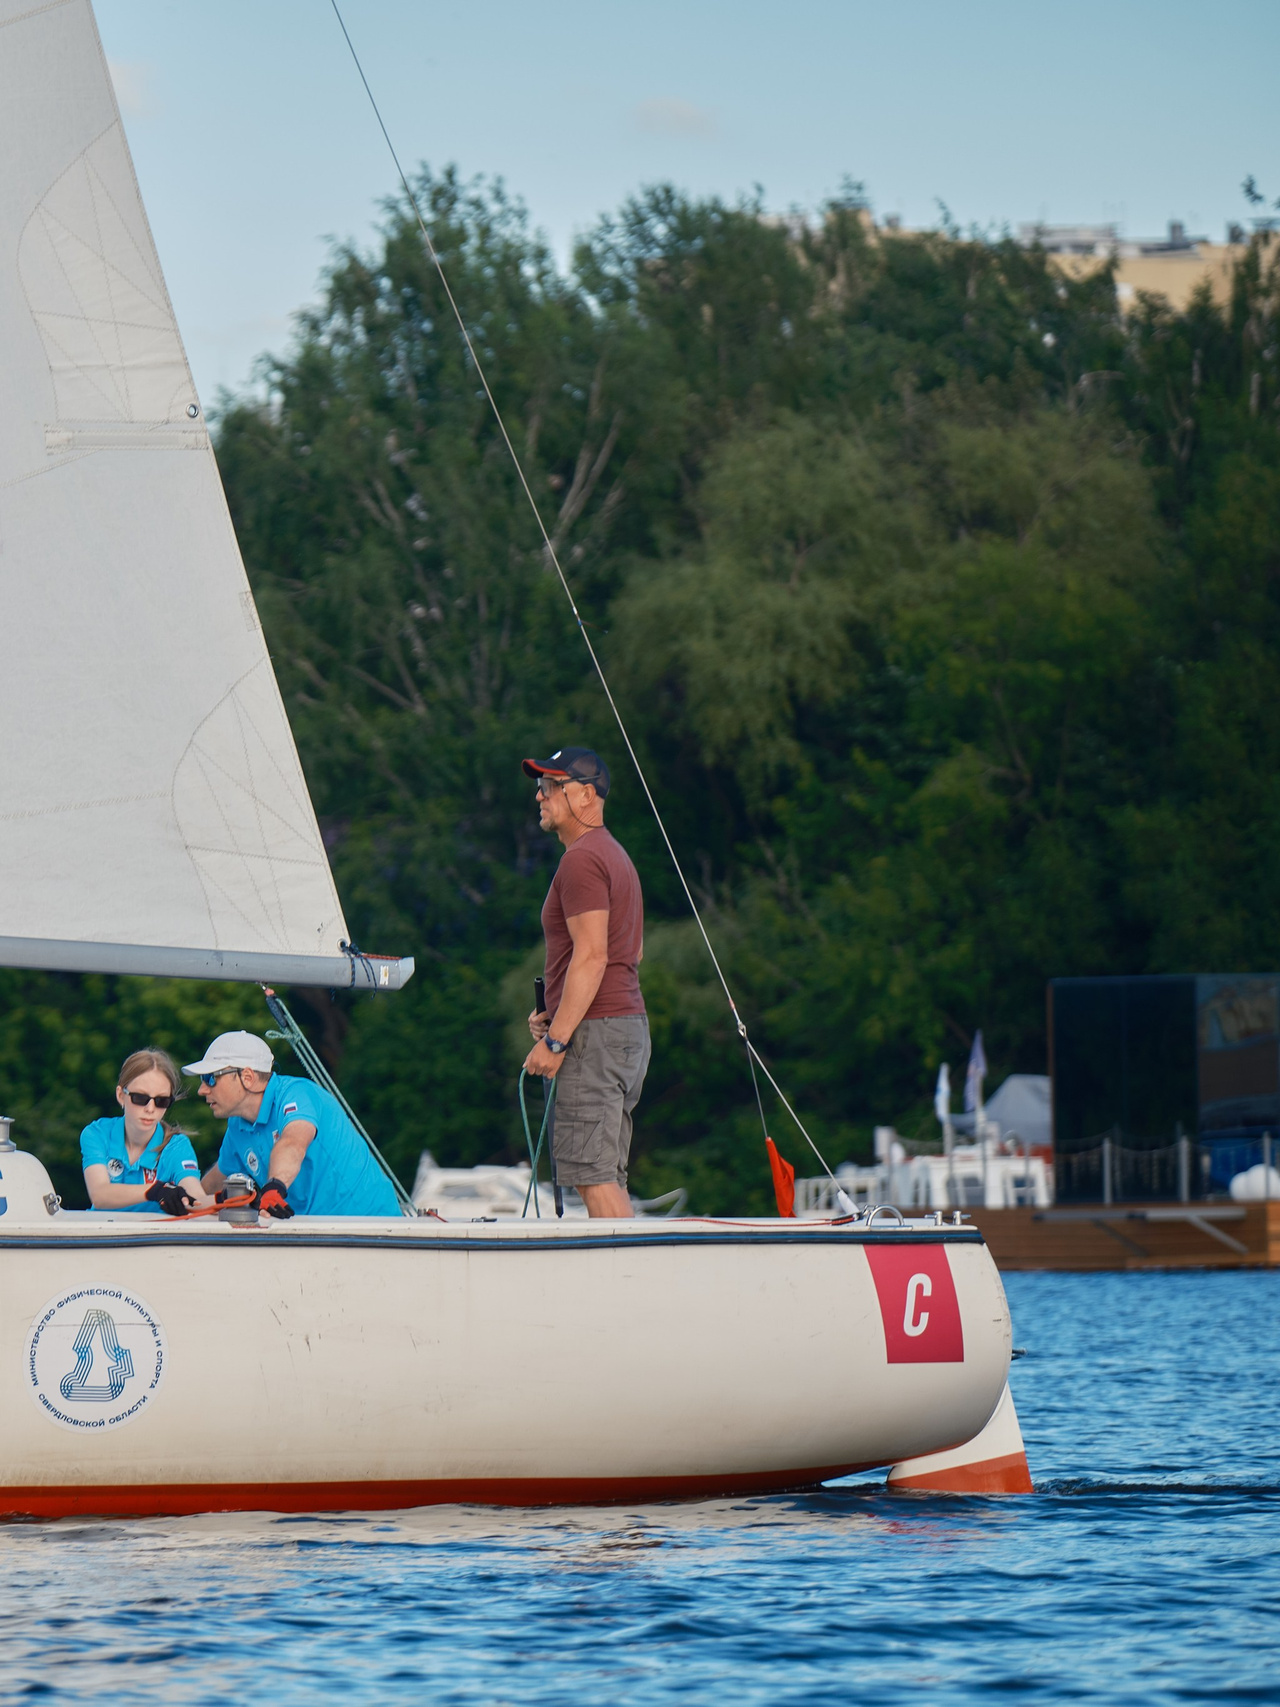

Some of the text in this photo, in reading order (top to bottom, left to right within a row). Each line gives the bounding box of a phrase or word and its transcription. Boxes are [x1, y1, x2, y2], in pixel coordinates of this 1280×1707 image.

[29, 1288, 163, 1389] МИНИСТЕРСТВО ФИЗИЧЕСКОЙ КУЛЬТУРЫ И СПОРТА
[38, 1393, 148, 1427] СВЕРДЛОВСКОЙ ОБЛАСТИ
